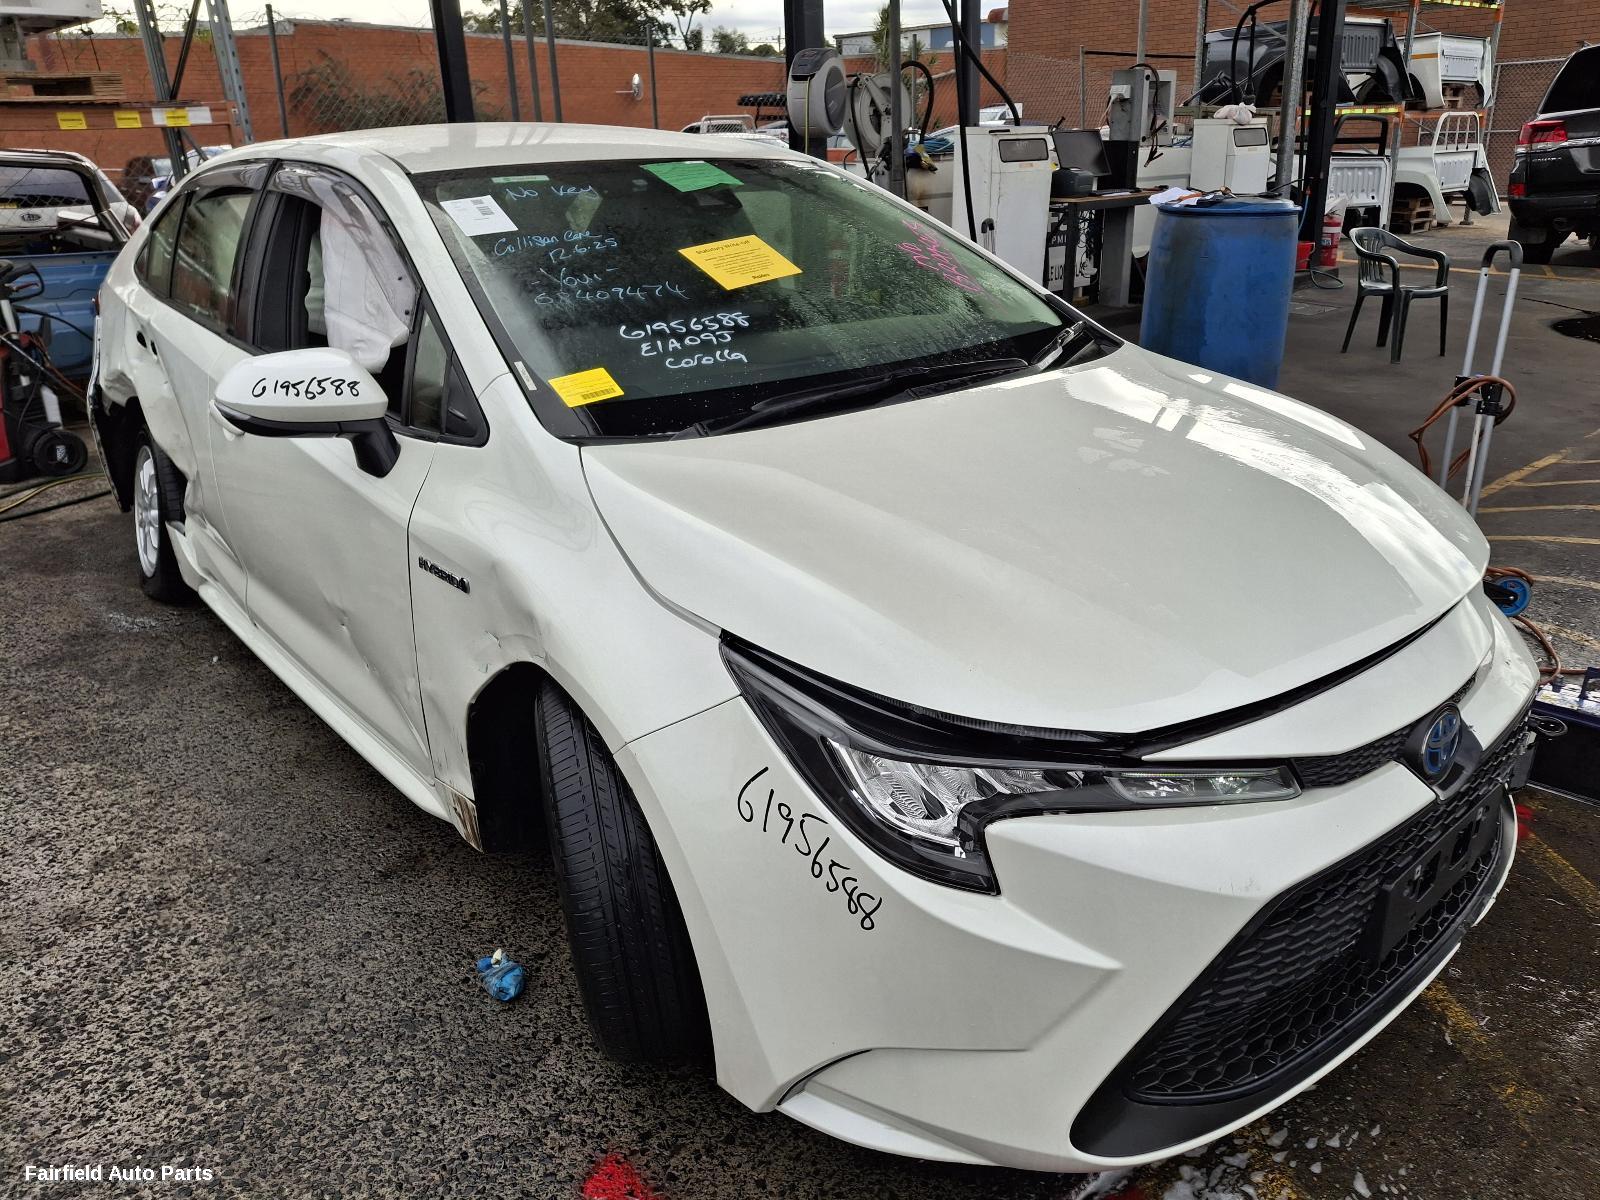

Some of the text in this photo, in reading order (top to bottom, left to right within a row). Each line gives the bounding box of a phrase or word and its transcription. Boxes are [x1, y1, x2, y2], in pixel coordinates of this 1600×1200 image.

[505, 186, 539, 200] No
[619, 312, 750, 339] 61956588
[252, 377, 361, 400] 61956588
[418, 556, 461, 591] HYBRID
[737, 766, 883, 931] 61956588
